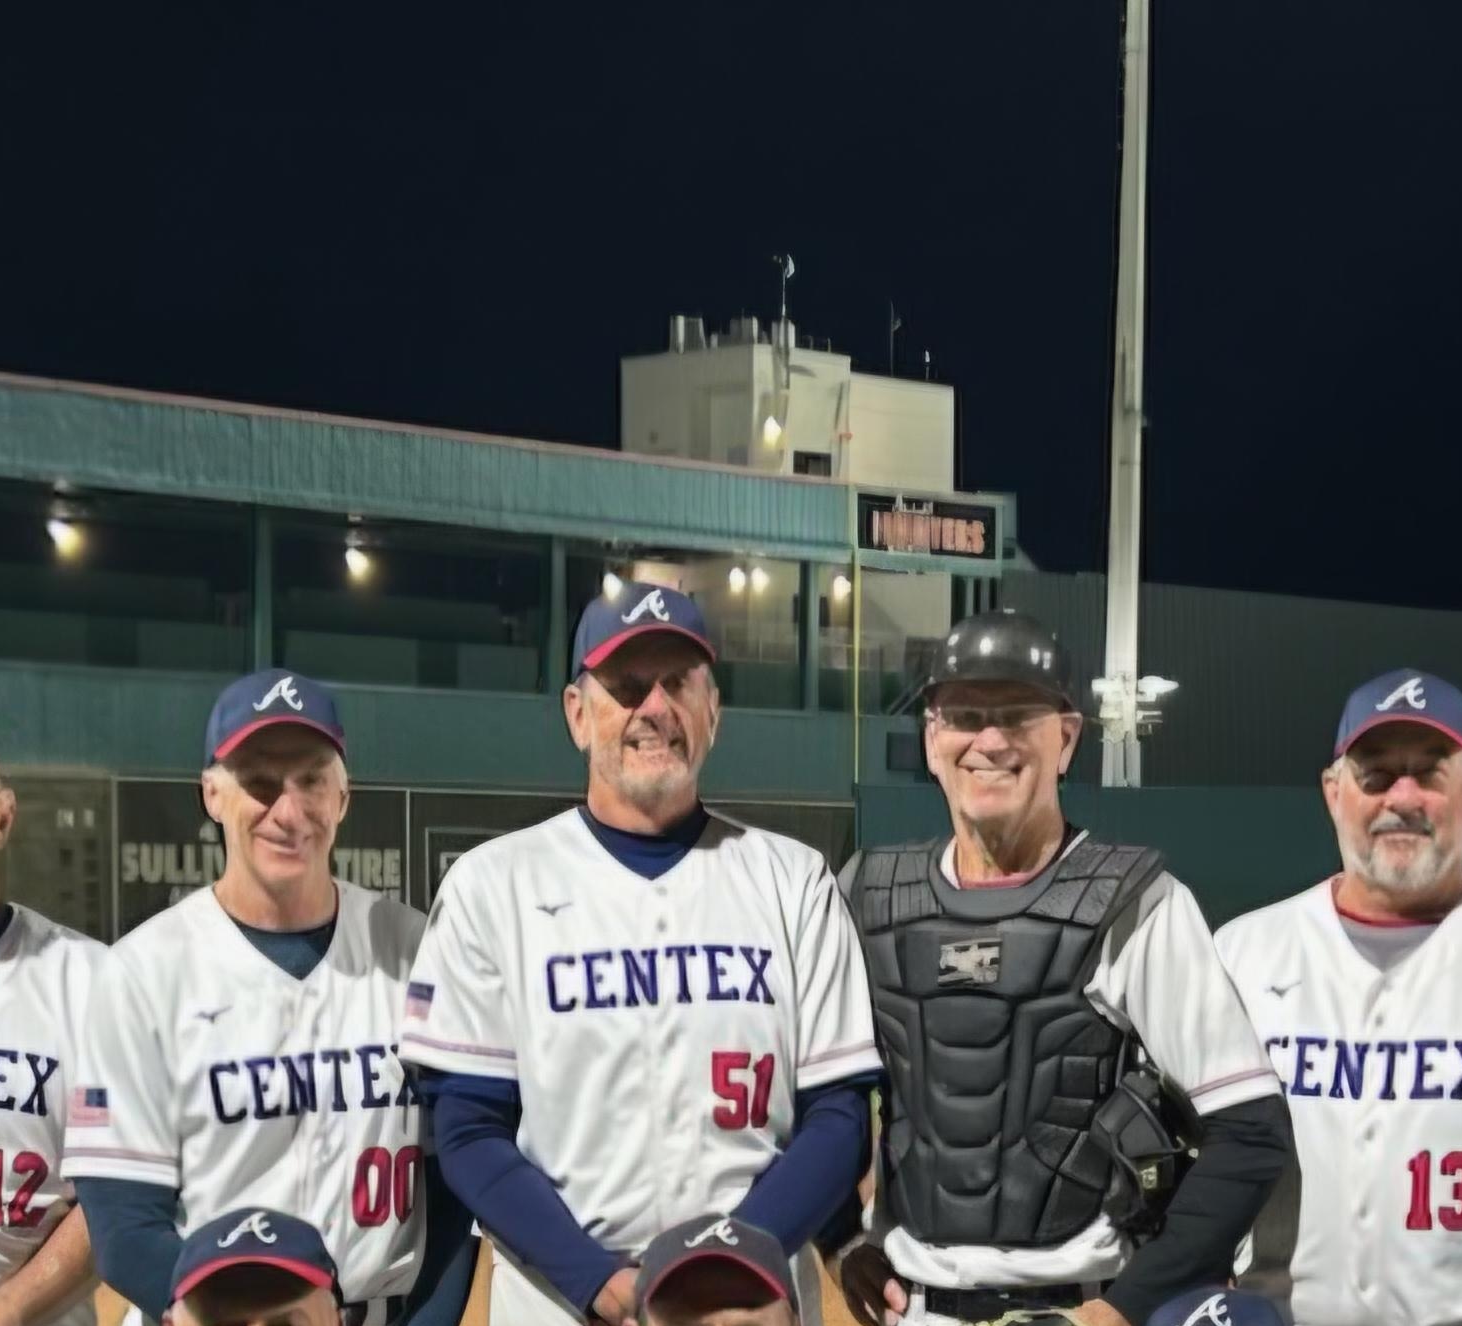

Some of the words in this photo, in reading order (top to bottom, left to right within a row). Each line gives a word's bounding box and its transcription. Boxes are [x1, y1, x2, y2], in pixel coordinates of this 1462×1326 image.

[121, 842, 226, 885] SULLI
[545, 945, 776, 1014] CENTEX
[710, 1050, 776, 1131] 51
